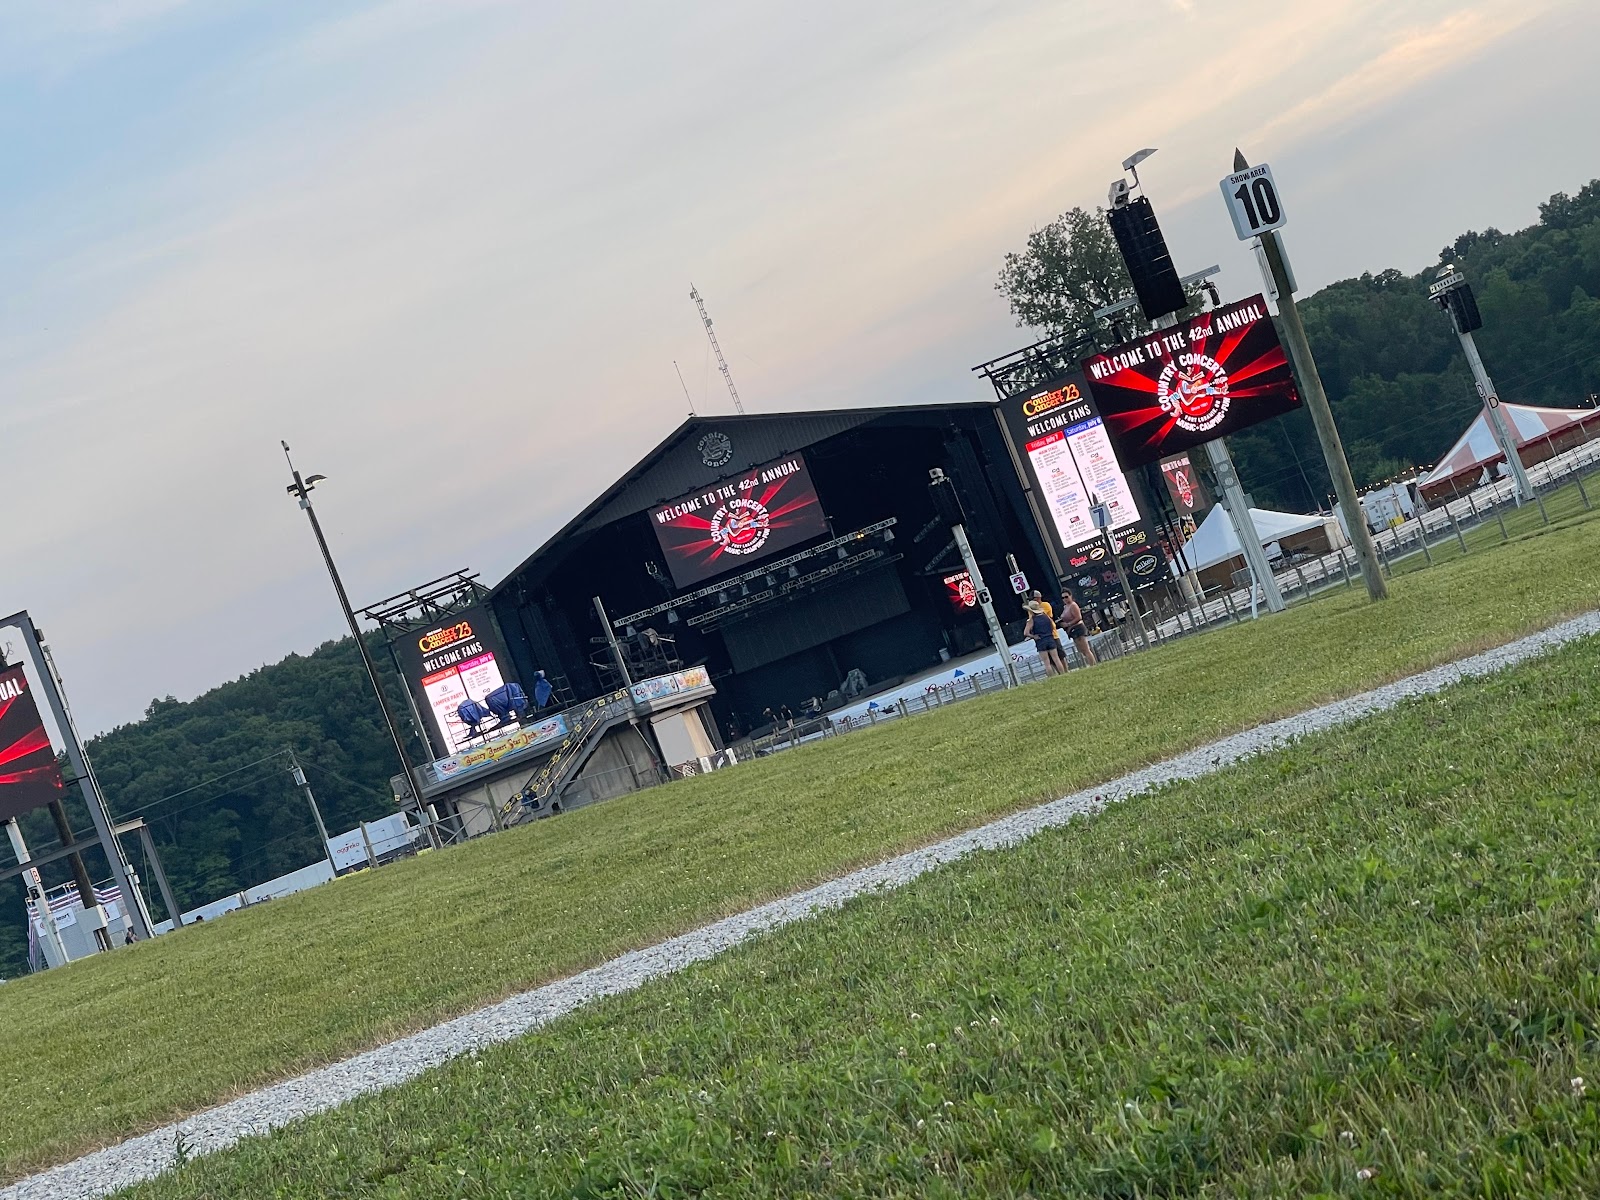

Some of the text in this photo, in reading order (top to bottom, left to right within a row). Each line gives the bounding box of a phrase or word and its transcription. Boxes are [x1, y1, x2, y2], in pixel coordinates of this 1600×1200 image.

[1231, 168, 1266, 184] SHOW AREA
[1234, 177, 1281, 229] 10
[1091, 303, 1263, 380] WELCOME TO THE 42nd ANNUAL
[1158, 352, 1226, 410] COUNTRY CONCERT
[1062, 384, 1080, 401] 23
[1488, 397, 1498, 409] D
[1027, 413, 1068, 437] WELCOME
[1069, 404, 1091, 421] FANS
[1176, 397, 1230, 431] MUSIC CAMPING FUN
[698, 432, 728, 451] country
[703, 450, 732, 466] concert
[656, 459, 800, 523] WELCOME TO THE 42nd ANNUAL
[711, 499, 769, 541] COUNTRY CONCERT
[1093, 508, 1104, 526] 7
[1013, 576, 1026, 592] 3
[979, 591, 990, 604] C
[455, 621, 472, 638] 23
[423, 649, 461, 672] WELCOME
[461, 642, 483, 658] FANS
[0, 678, 23, 702] UAL
[507, 737, 521, 750] Star
[337, 843, 360, 854] aggreko
[30, 889, 40, 900] B
